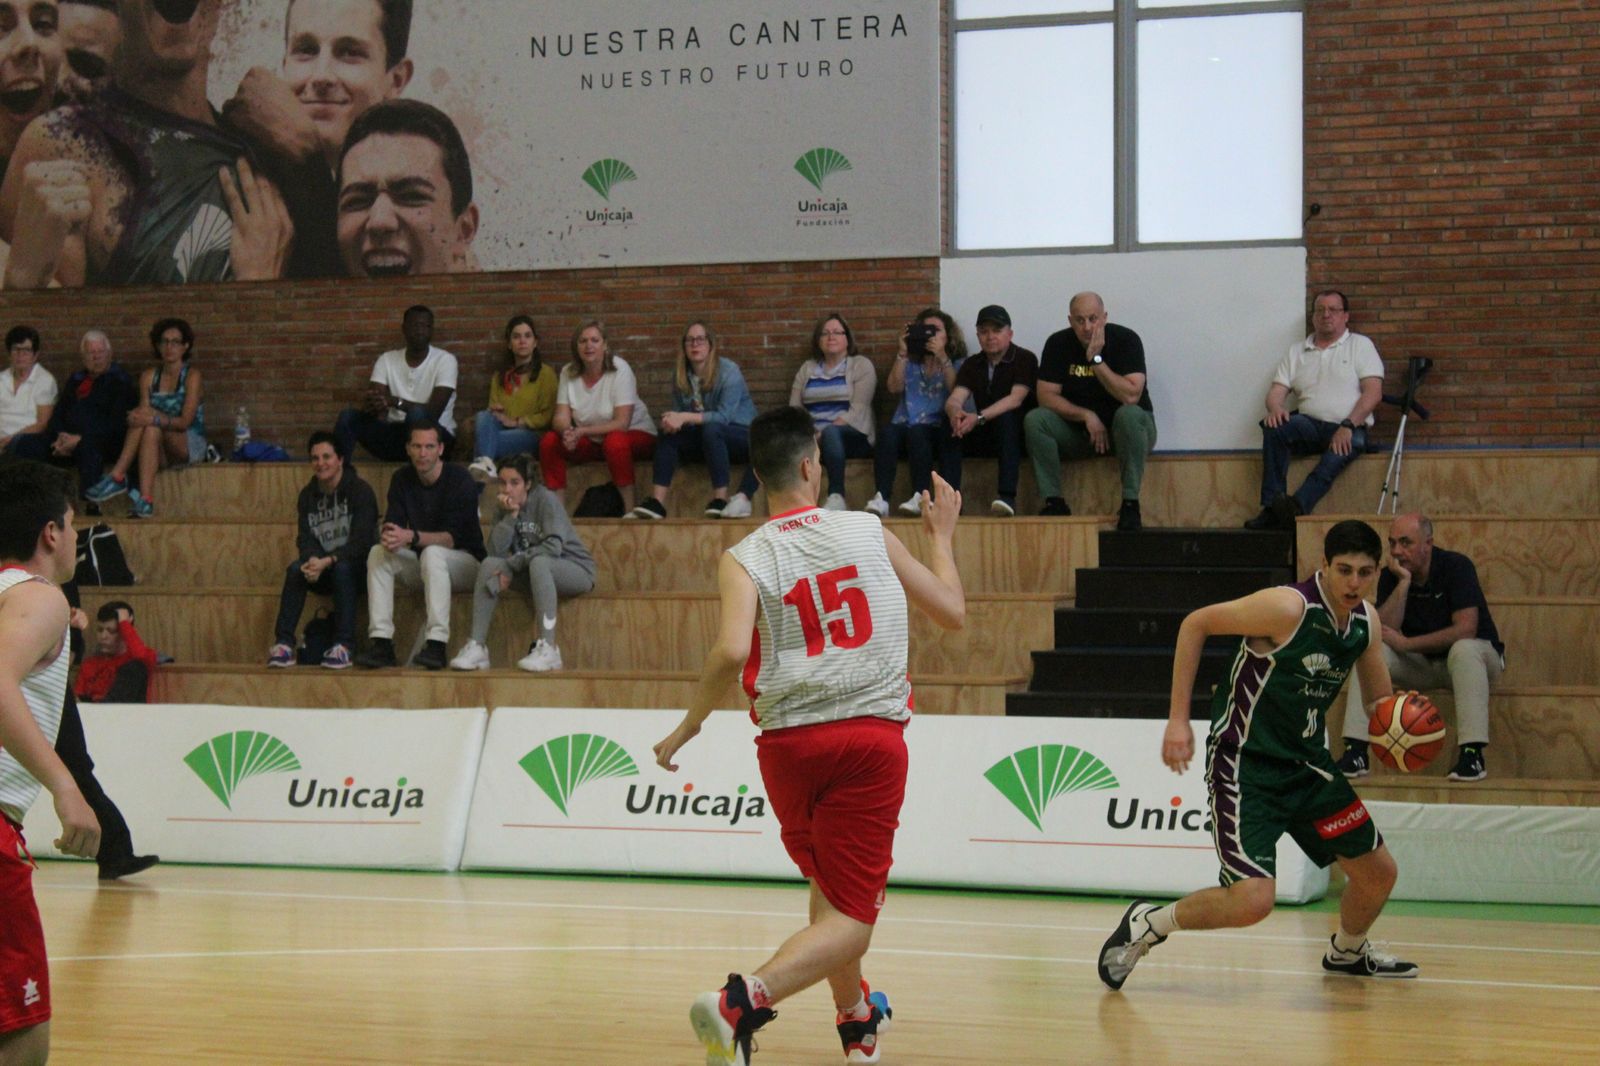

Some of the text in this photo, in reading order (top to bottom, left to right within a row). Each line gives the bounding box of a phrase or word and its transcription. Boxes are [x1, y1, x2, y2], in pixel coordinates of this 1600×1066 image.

[531, 14, 908, 58] NUESTRA CANTERA
[581, 58, 854, 90] NUESTRO FUTURO
[586, 206, 633, 223] Unicaja
[798, 197, 848, 214] Unicaja
[783, 564, 873, 657] 15
[288, 776, 424, 817] Unicaja
[625, 782, 766, 825] Unicaja
[1107, 796, 1213, 832] Unic
